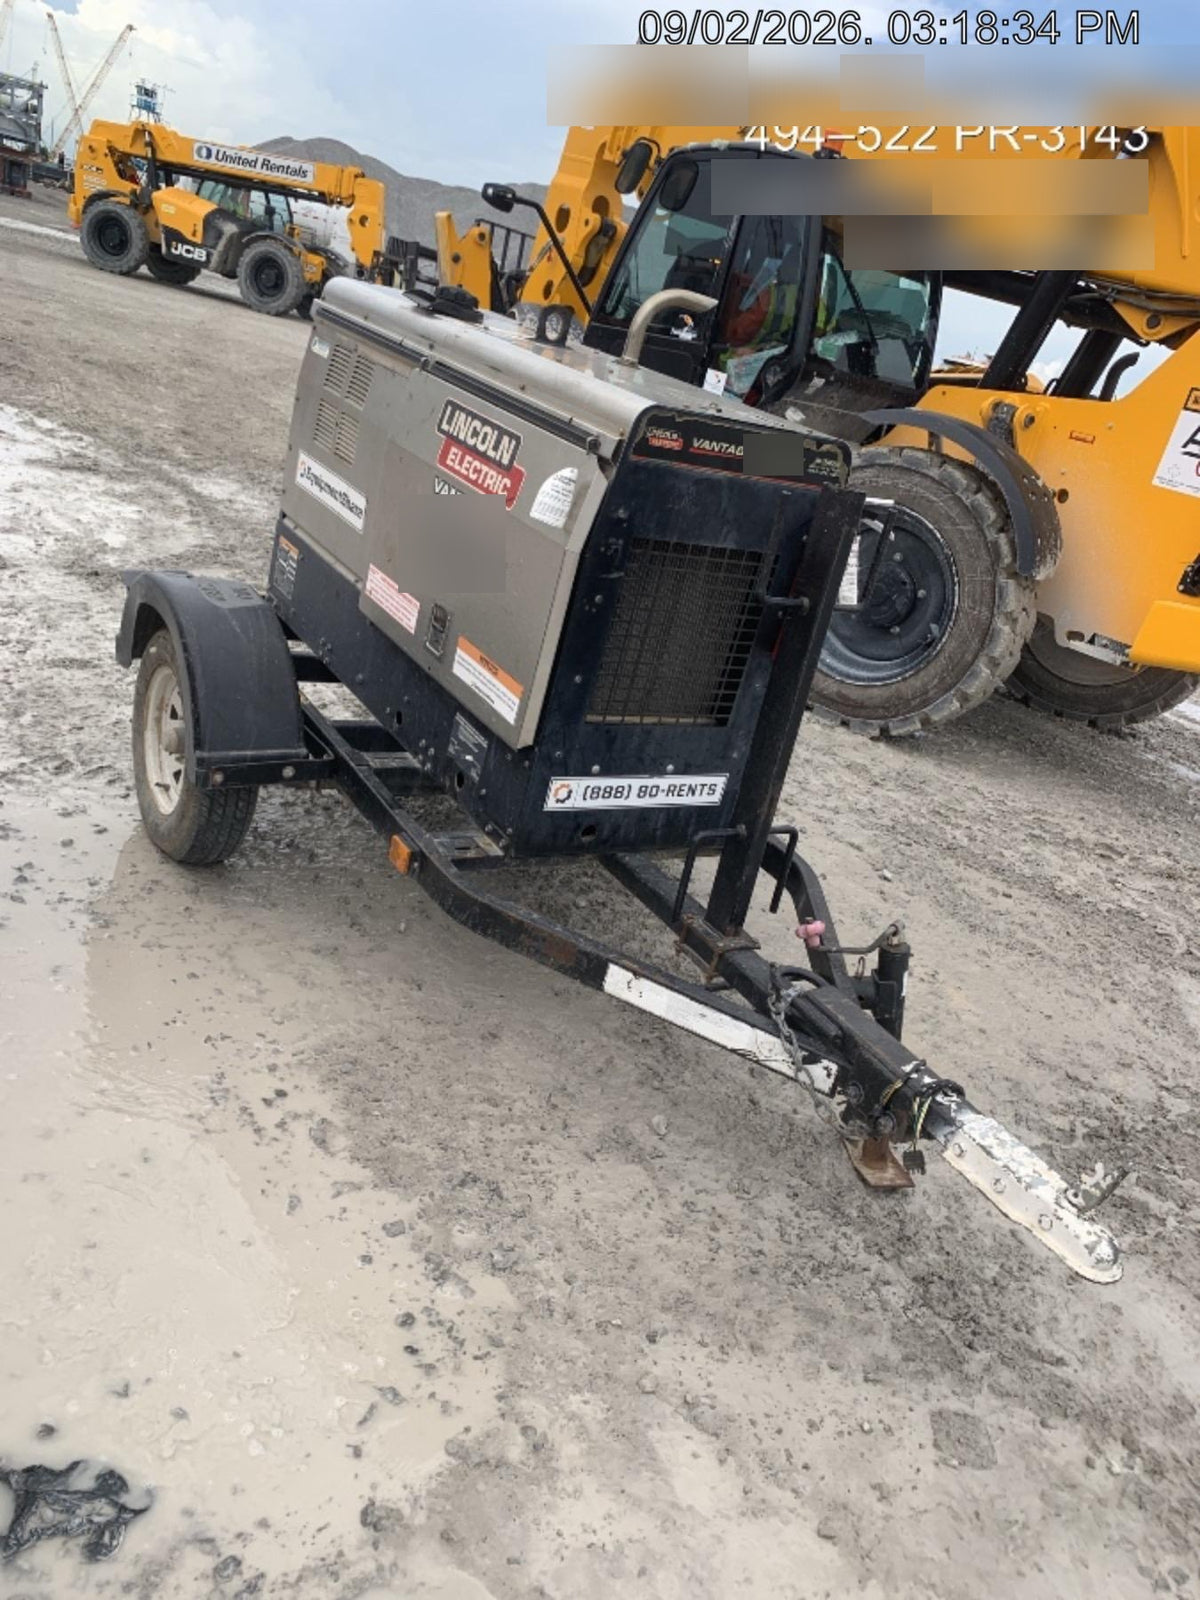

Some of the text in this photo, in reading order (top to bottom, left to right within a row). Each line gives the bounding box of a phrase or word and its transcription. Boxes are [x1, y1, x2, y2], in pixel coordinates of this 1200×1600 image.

[214, 148, 309, 179] United Rentals
[170, 240, 208, 262] JCB
[440, 404, 517, 467] LINCOLN
[445, 445, 512, 495] ELECTRIC
[582, 782, 718, 801] (888) 80-RENTS
